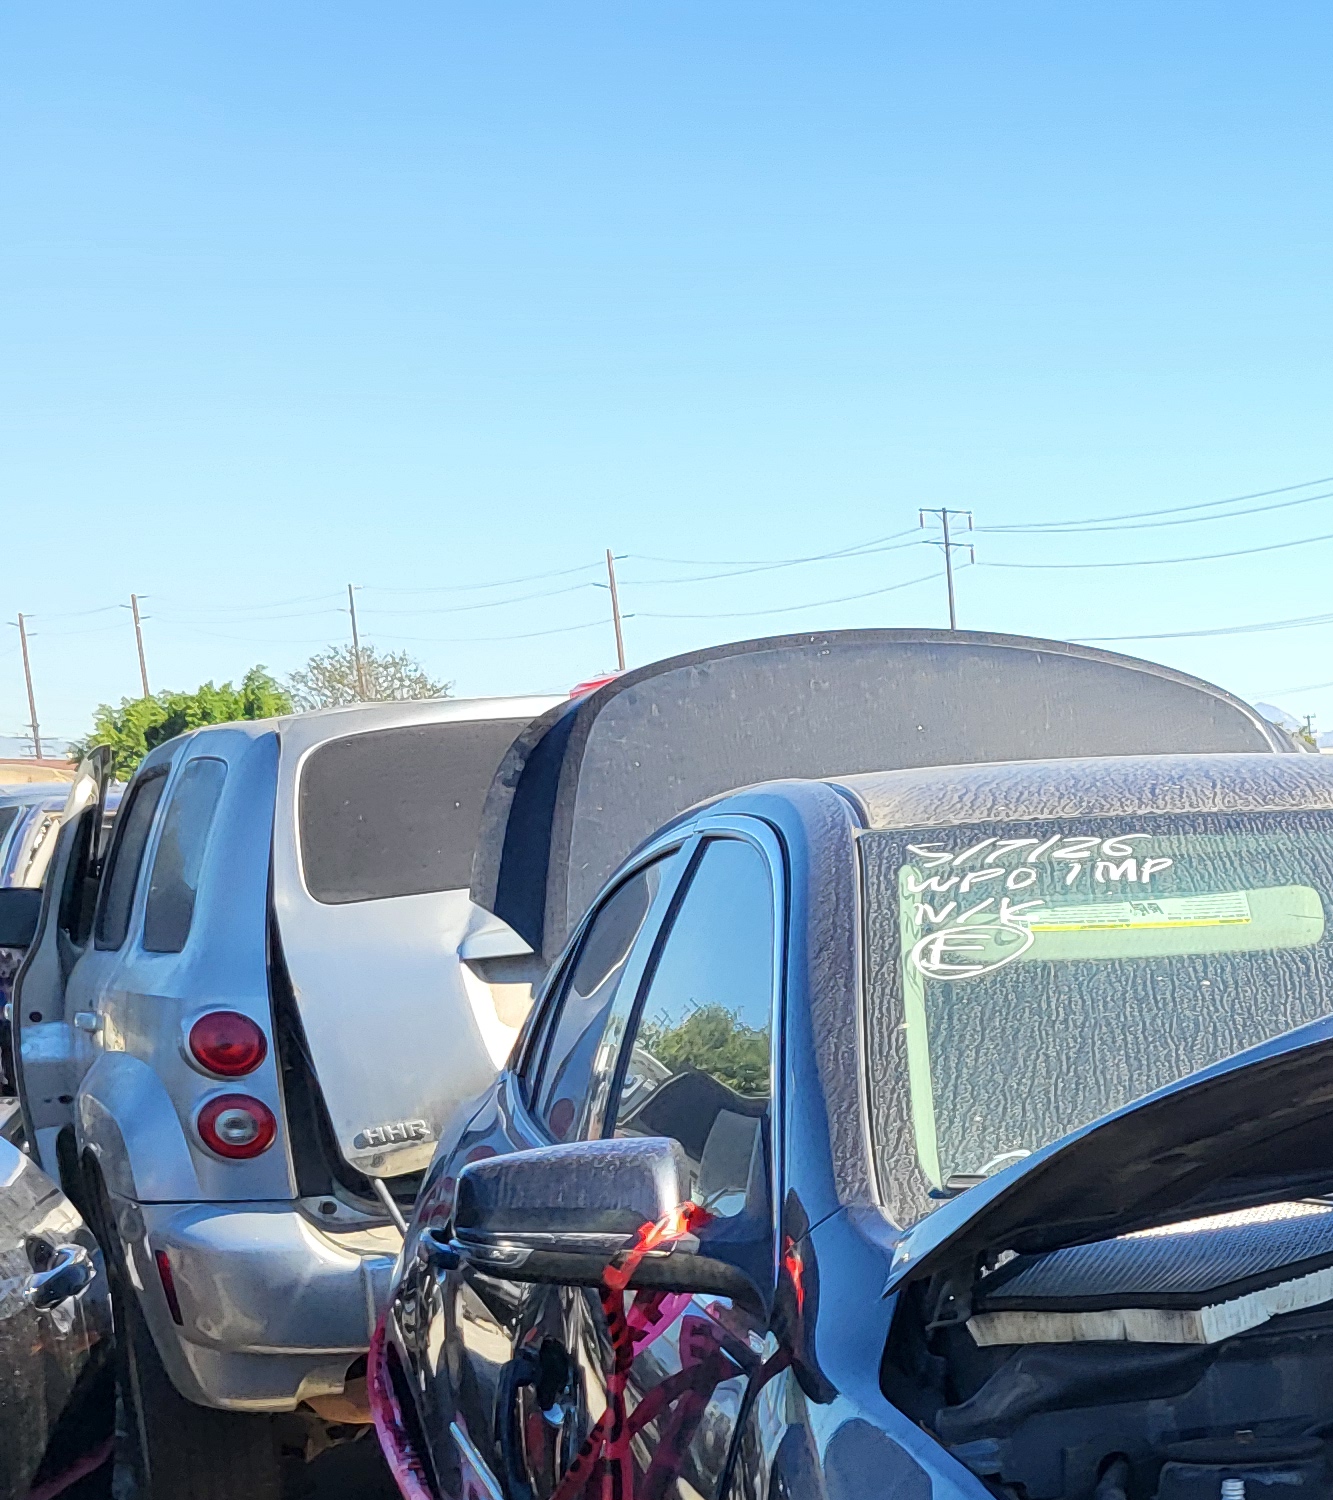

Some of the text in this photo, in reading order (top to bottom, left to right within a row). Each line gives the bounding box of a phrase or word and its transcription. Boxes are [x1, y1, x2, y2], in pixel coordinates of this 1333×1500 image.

[906, 833, 1152, 868] 5/7/26
[913, 897, 1045, 926] N/K
[362, 1119, 431, 1145] HHR
